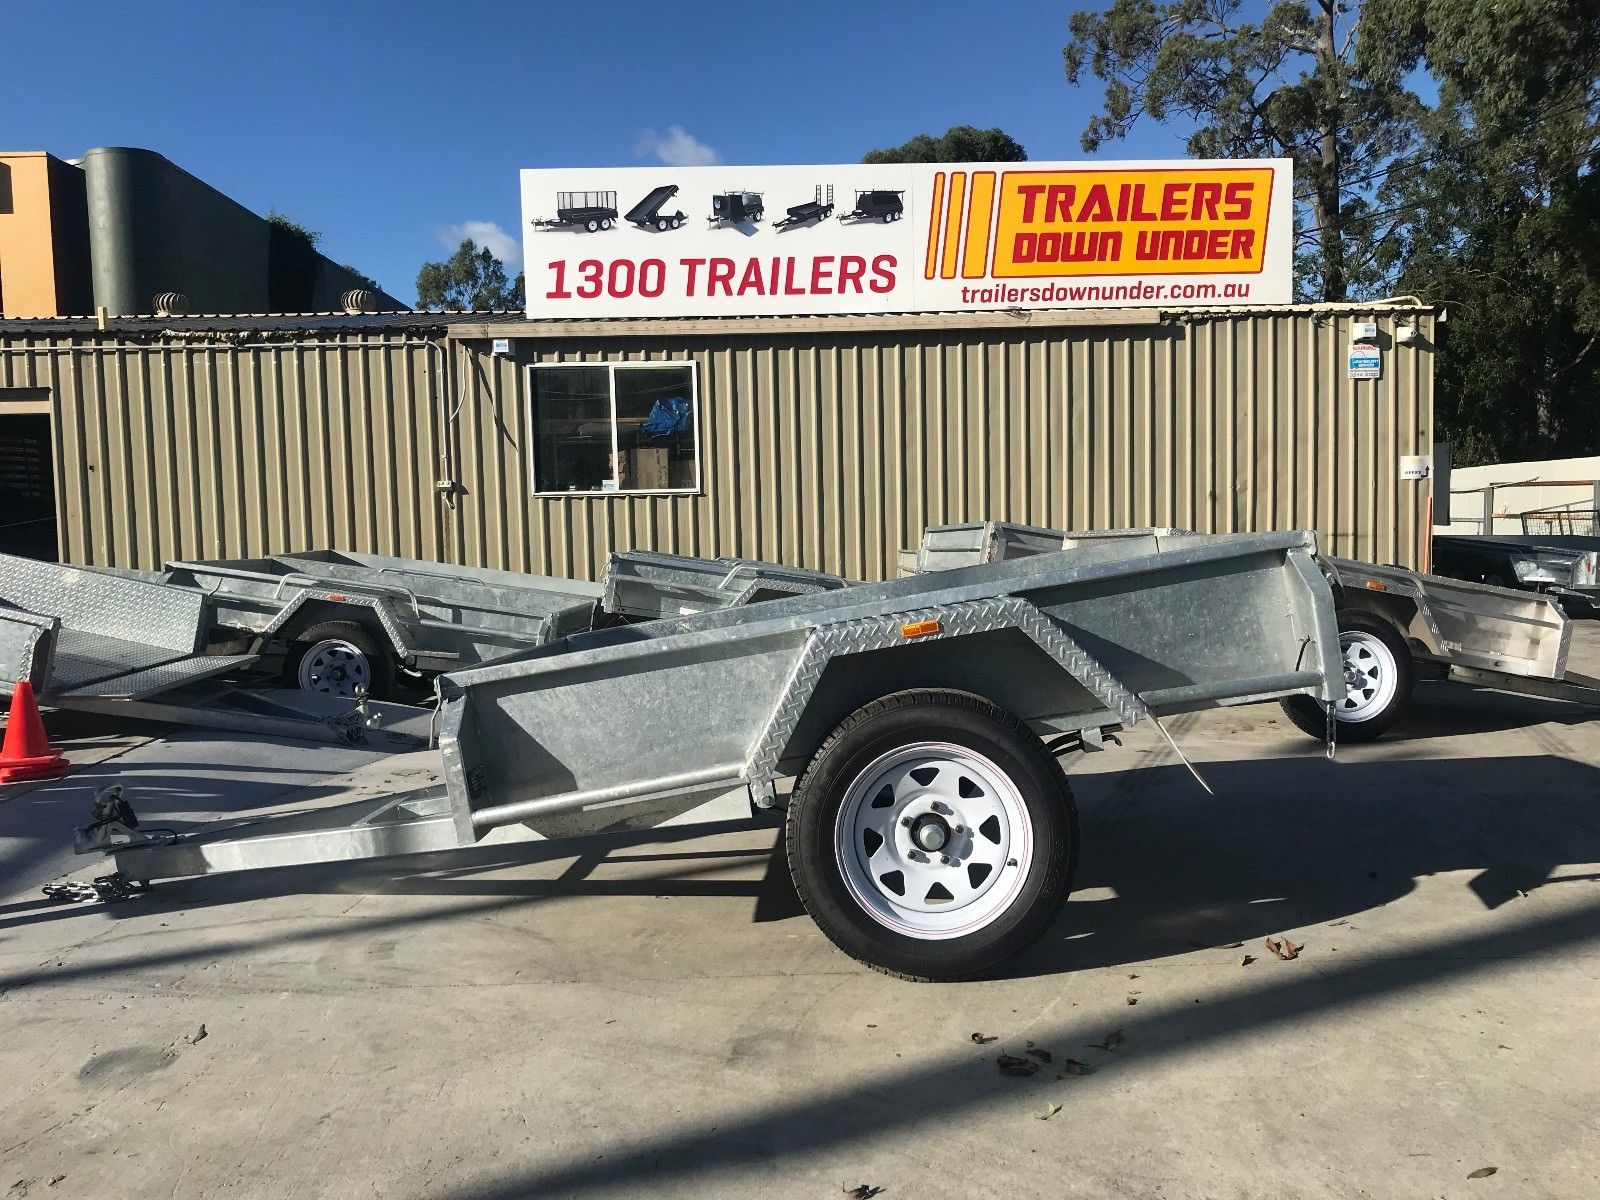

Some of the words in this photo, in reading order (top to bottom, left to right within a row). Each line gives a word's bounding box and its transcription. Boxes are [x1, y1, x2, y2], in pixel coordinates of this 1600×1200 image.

[1018, 183, 1254, 223] TRAILERS
[1012, 231, 1122, 263] DOWN
[1136, 229, 1255, 260] UNDER
[547, 259, 665, 298] 1300
[680, 255, 896, 296] TRAILERS
[961, 281, 1250, 304] trailersdownunder.com.au
